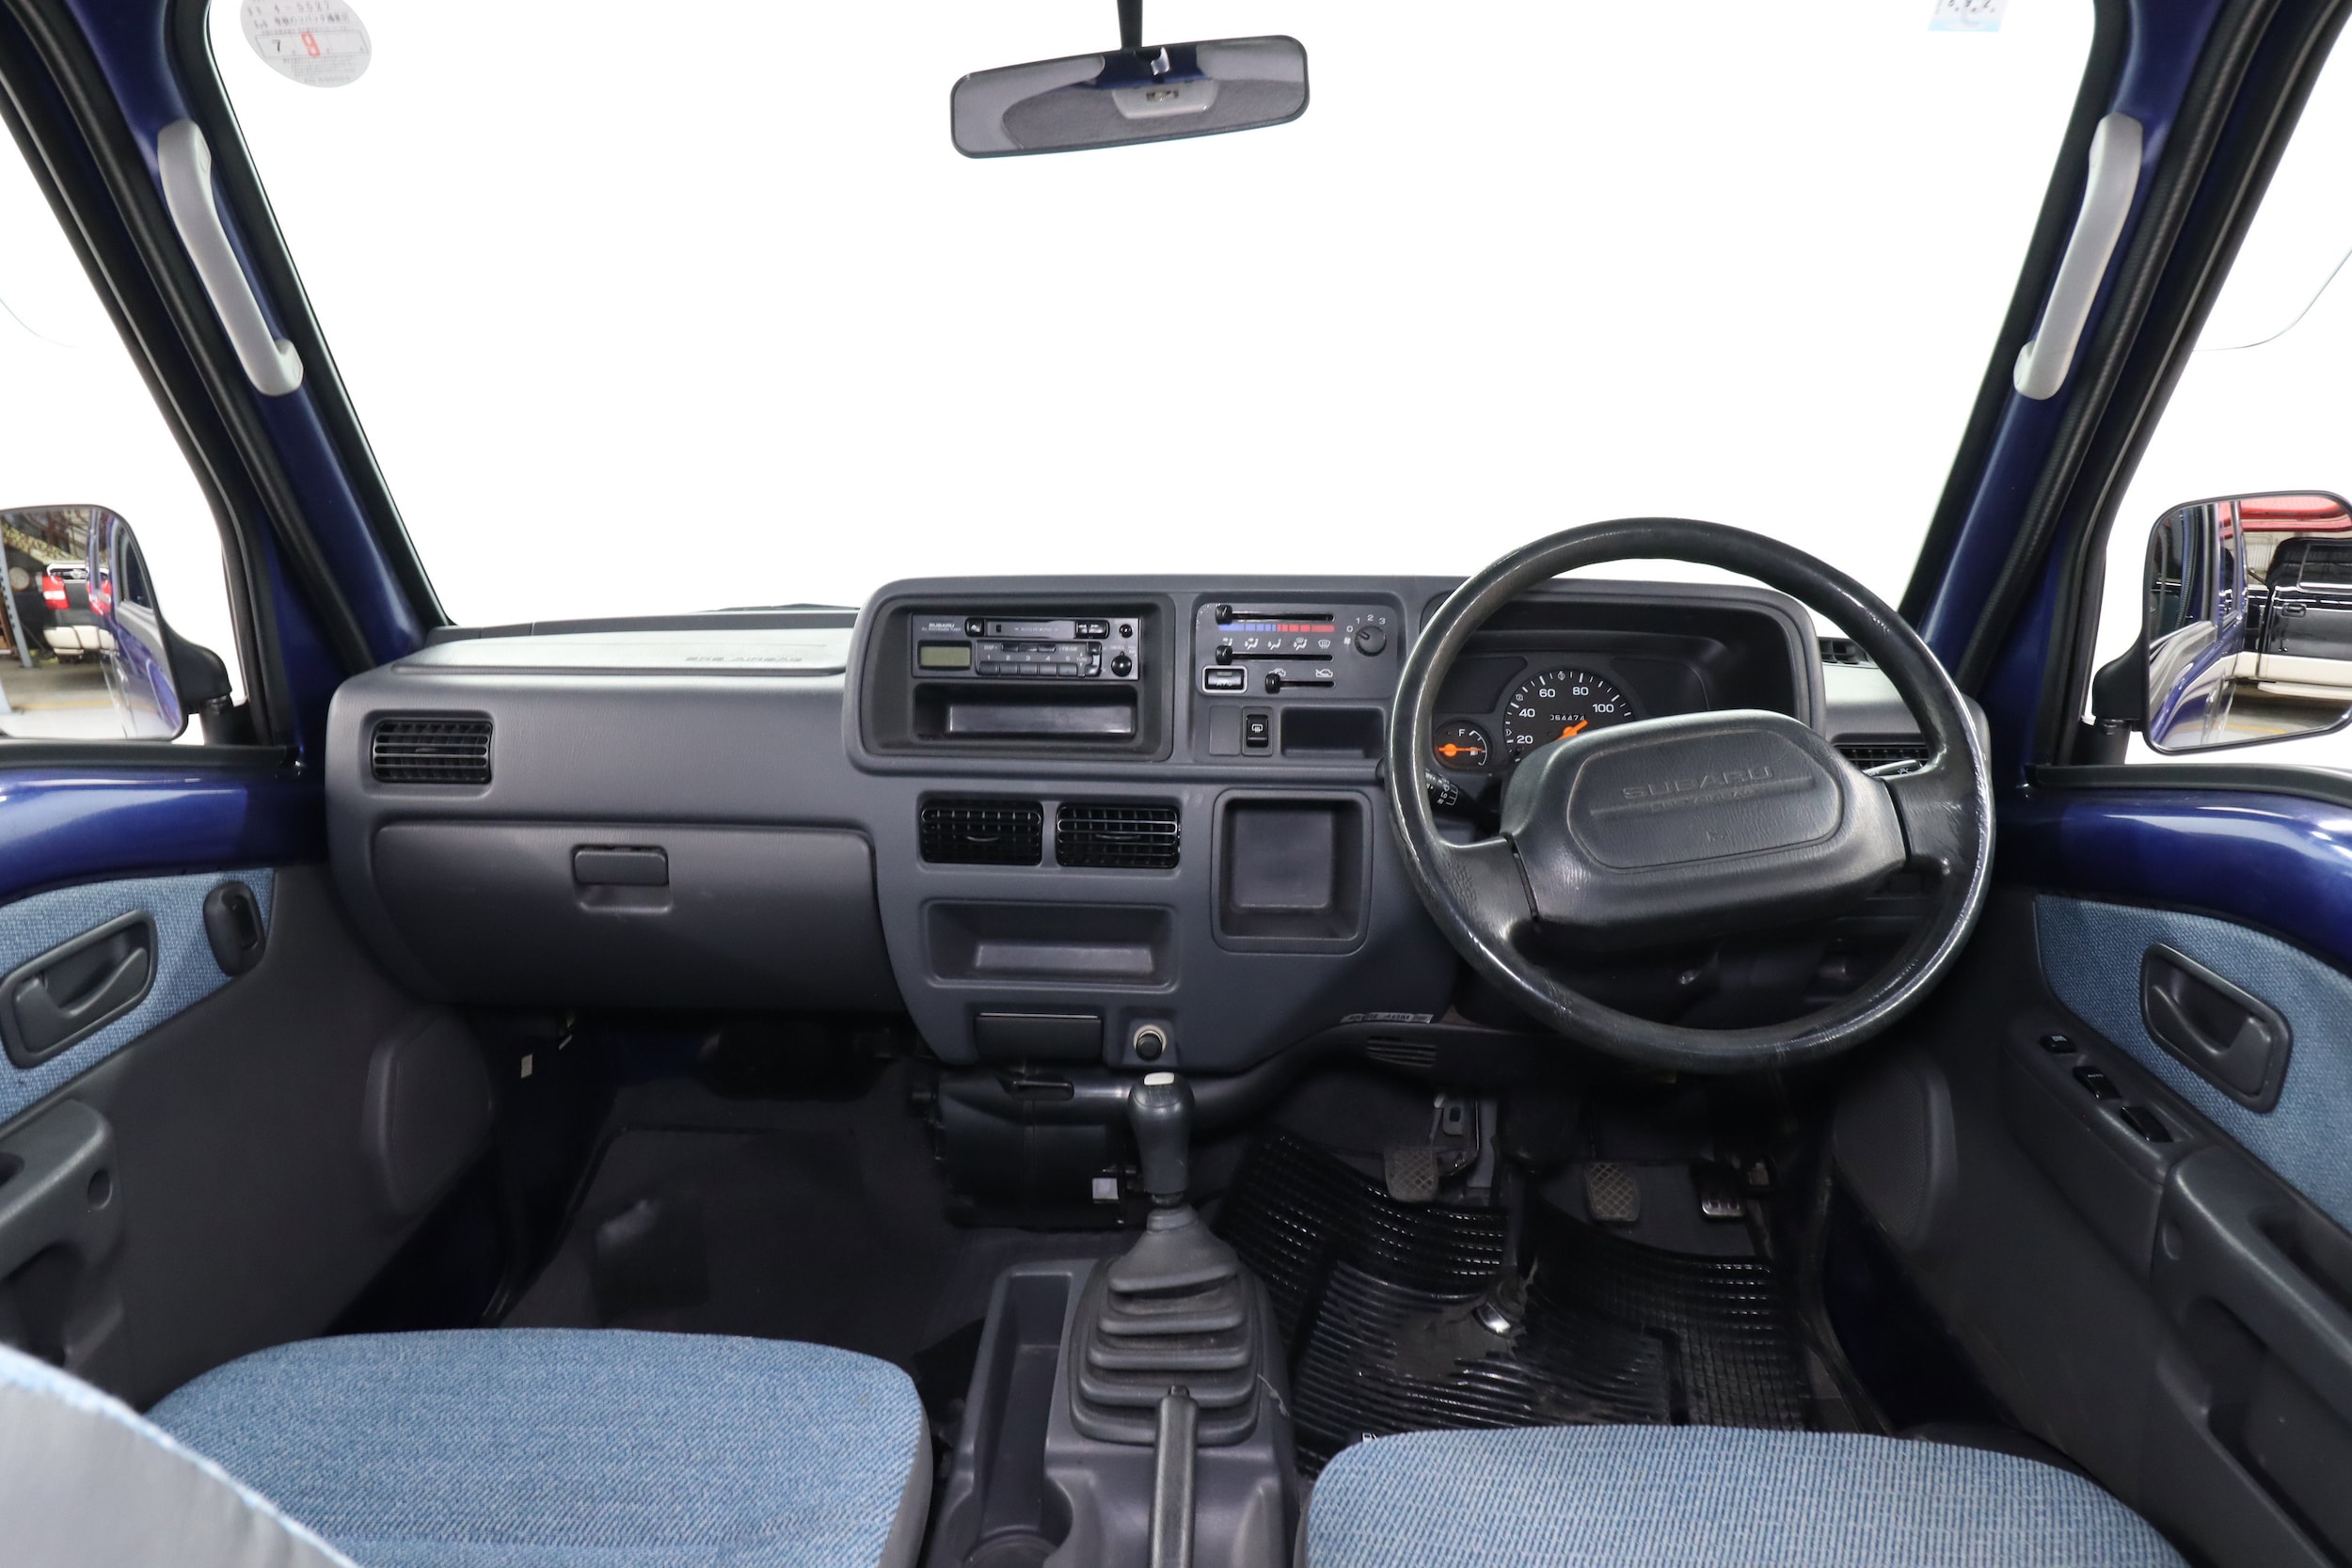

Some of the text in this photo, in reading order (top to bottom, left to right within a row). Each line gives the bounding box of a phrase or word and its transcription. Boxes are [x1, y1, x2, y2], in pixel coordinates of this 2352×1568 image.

[1539, 689, 1556, 698] 60
[1572, 687, 1589, 696] 80
[1518, 708, 1535, 718] 40
[1592, 704, 1614, 713] 100
[1458, 729, 1466, 737] F
[1517, 735, 1534, 744] 20
[1623, 766, 1775, 800] SUBARU
